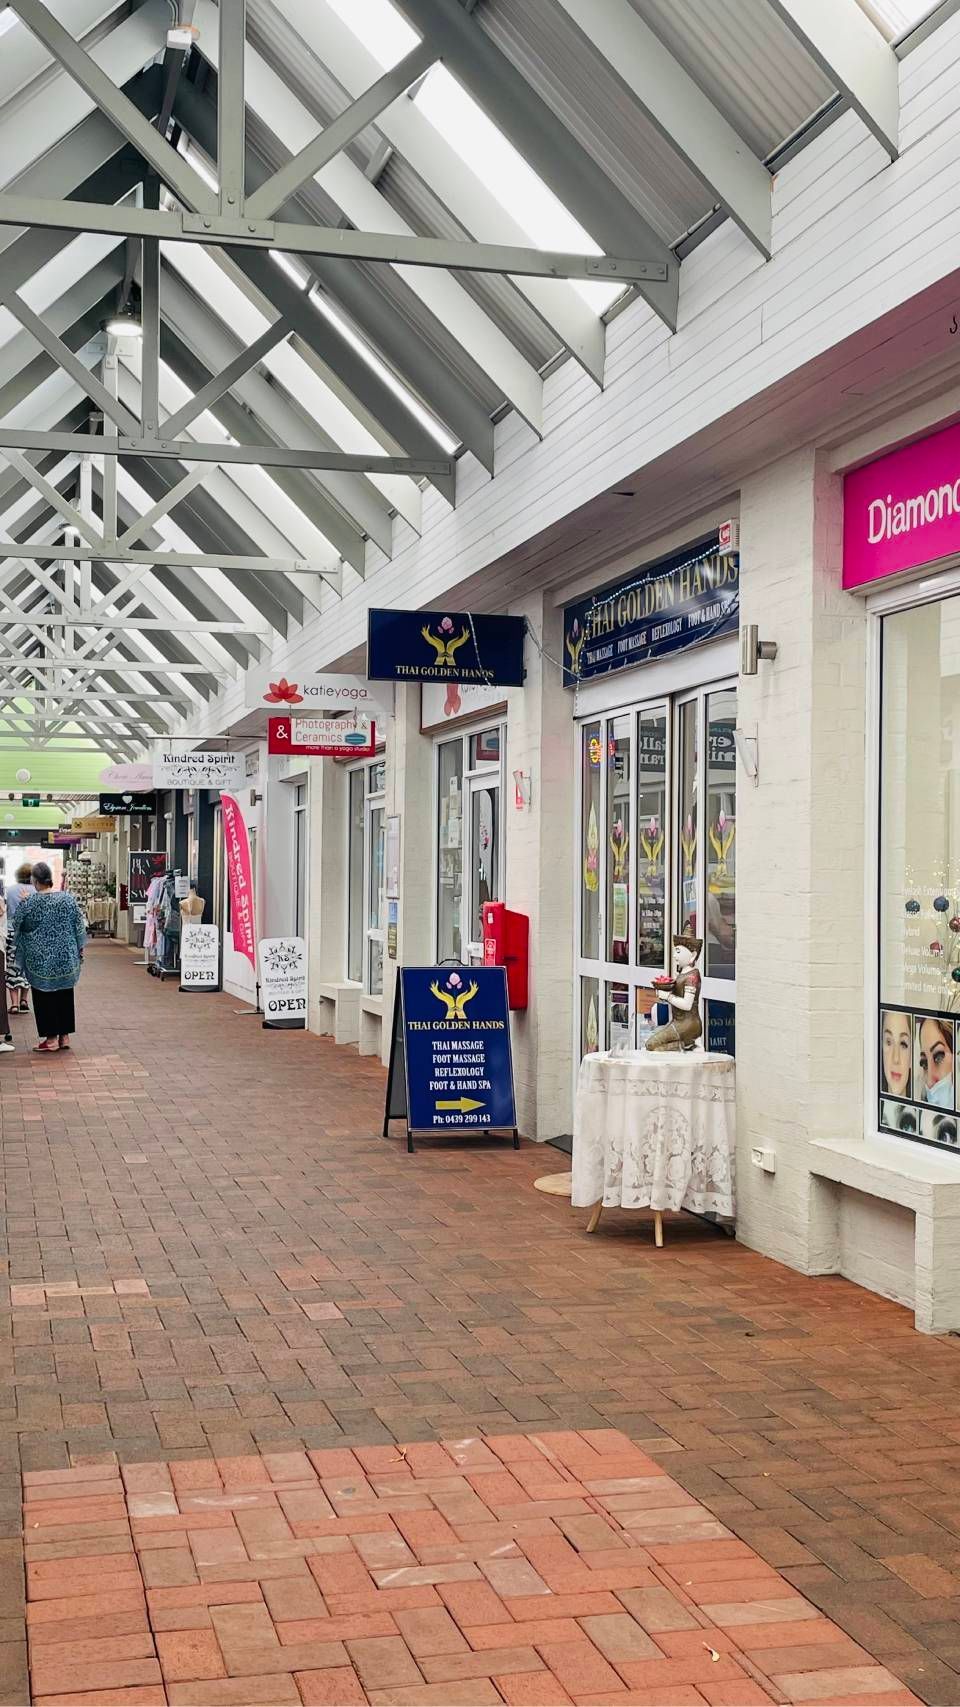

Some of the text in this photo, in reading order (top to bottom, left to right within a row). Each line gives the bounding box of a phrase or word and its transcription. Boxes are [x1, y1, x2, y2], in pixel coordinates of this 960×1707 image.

[617, 574, 675, 628] GOLDEN
[679, 555, 738, 603] HANDS
[617, 638, 628, 654] FOOT
[628, 631, 648, 650] MASSAGE
[652, 617, 682, 642] REFLEXOLOGY
[688, 610, 701, 629] FOOT
[706, 603, 720, 621] HAND
[395, 665, 495, 678] THAI GOLDEN HANDS
[303, 684, 368, 699] katieyoga
[295, 718, 357, 732] Photography
[276, 725, 288, 739] &
[295, 731, 342, 743] Ceramics
[163, 753, 236, 765] Kindred Spirit
[225, 803, 254, 953] Kindred Spirit
[184, 970, 215, 981] OPEN
[268, 997, 306, 1012] OPEN
[408, 1020, 505, 1030] THAI GOLDEN HANDS
[432, 1040, 484, 1050] THAI MASSAGE
[432, 1053, 485, 1064] FOOT MASSAGE
[434, 1066, 485, 1077] REFLEXOLOGY
[429, 1079, 491, 1090] FOOT & HAND SPA
[433, 1114, 491, 1124] Ph: 0439 299 143
